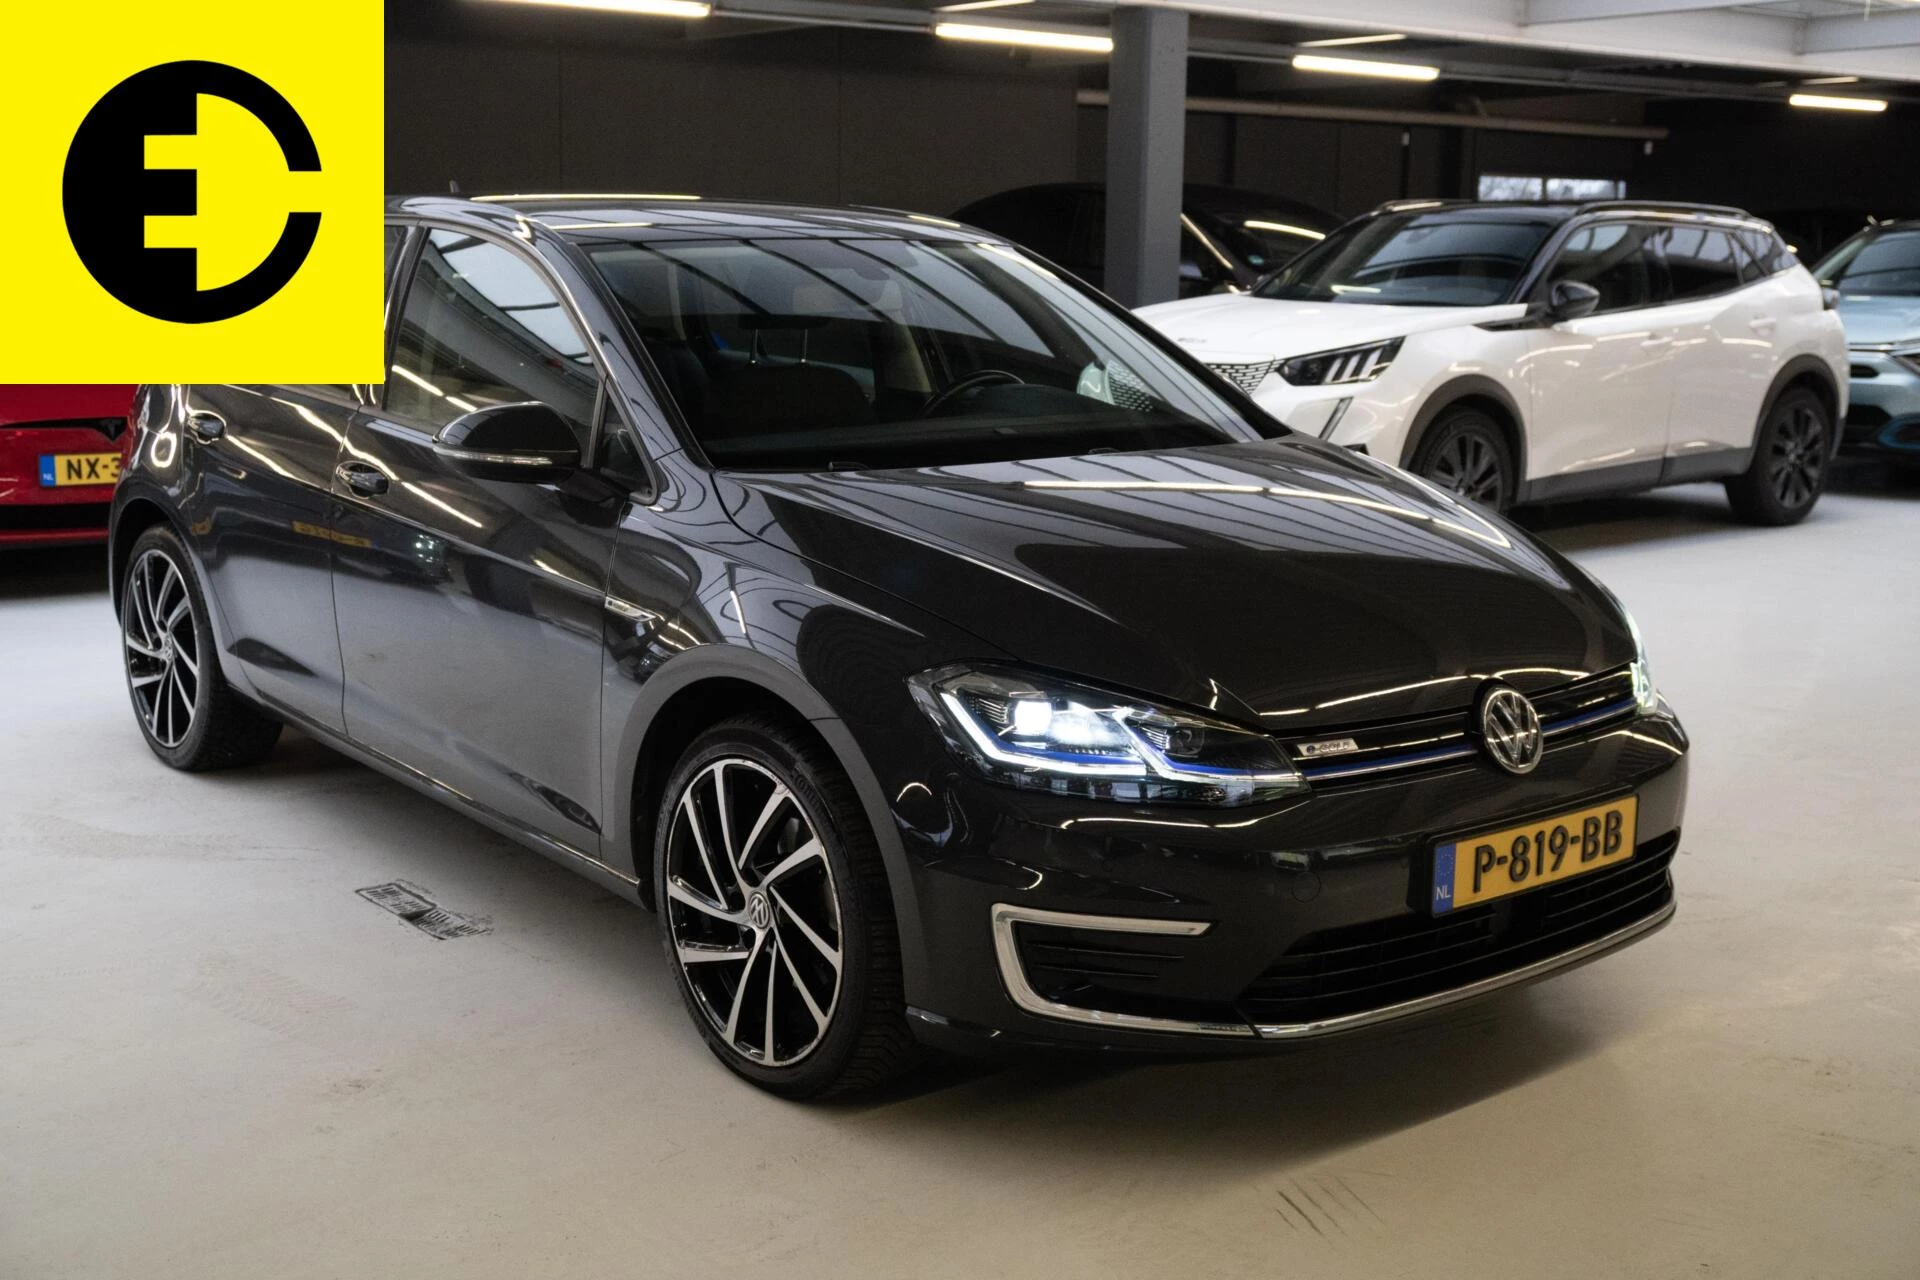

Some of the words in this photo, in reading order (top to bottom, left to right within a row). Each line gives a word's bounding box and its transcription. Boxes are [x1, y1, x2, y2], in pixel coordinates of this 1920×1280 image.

[42, 473, 54, 482] NL
[1436, 886, 1451, 902] NL
[1473, 809, 1623, 894] P-819-BB
